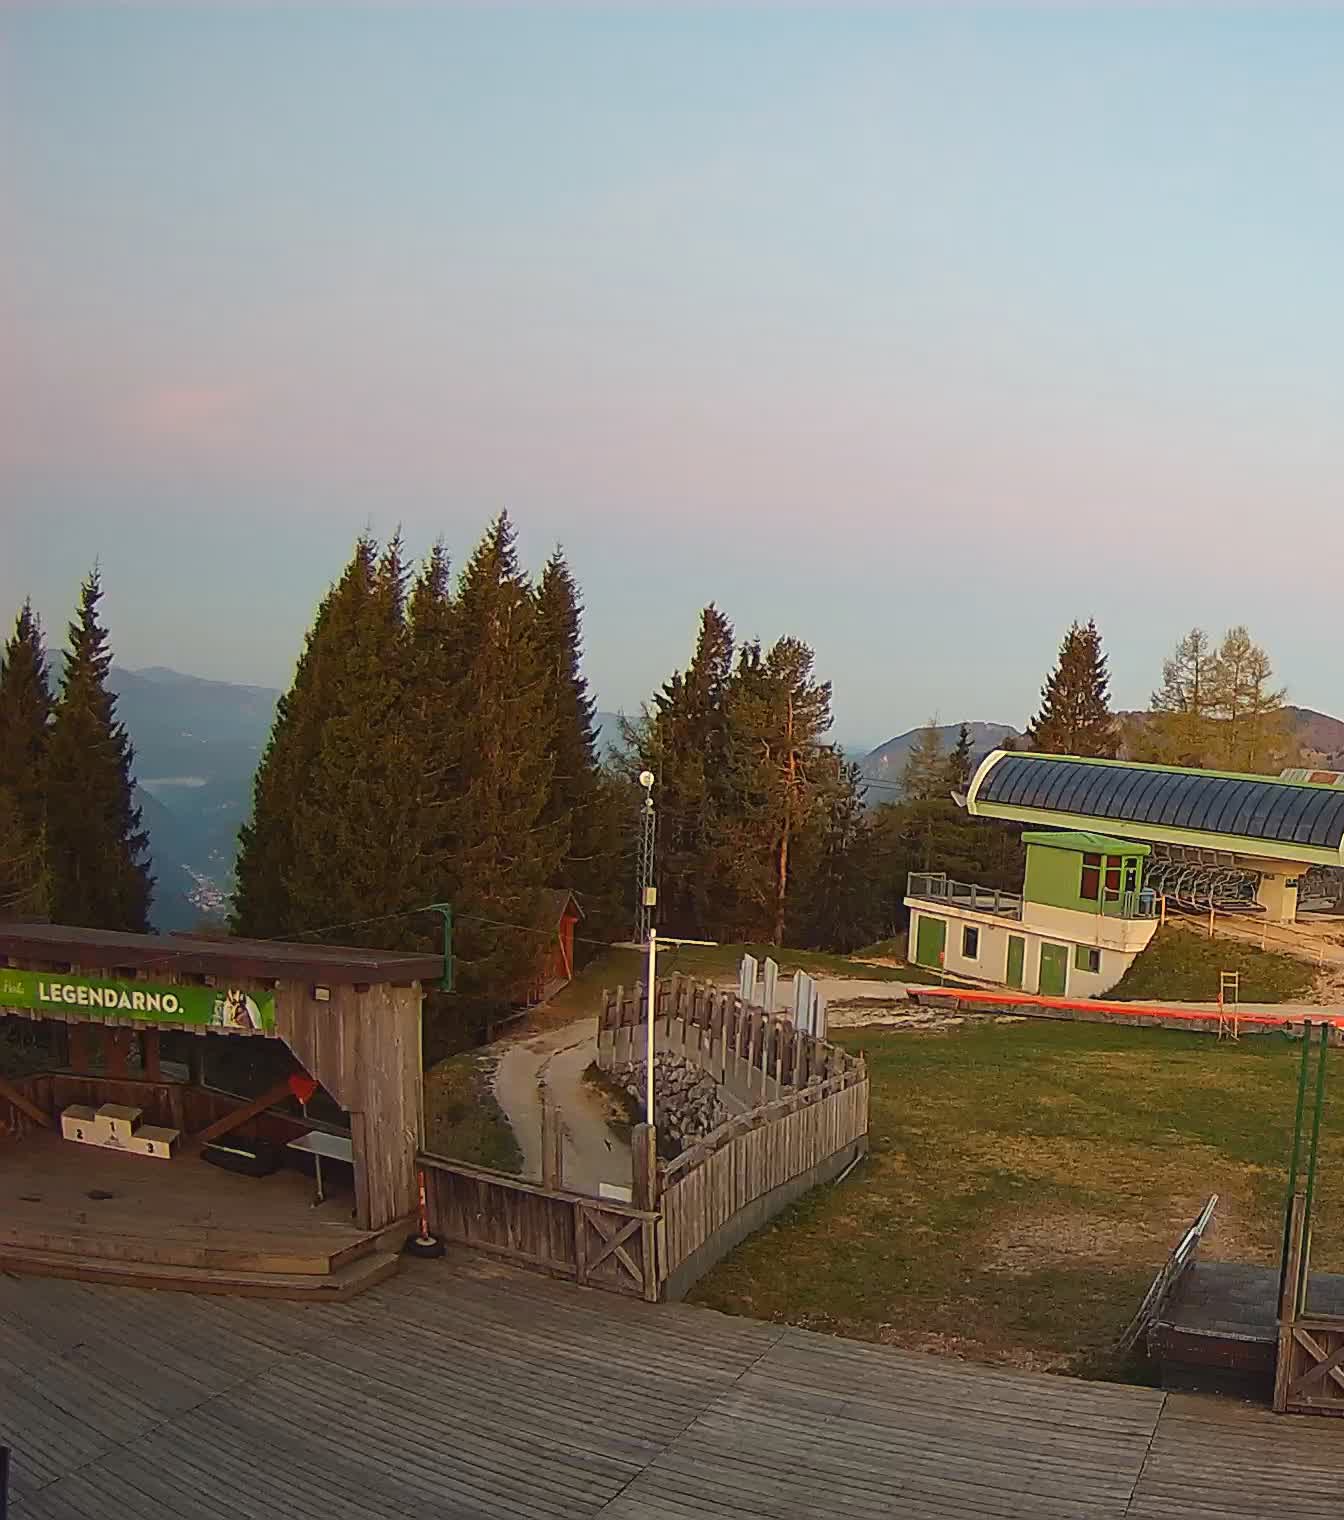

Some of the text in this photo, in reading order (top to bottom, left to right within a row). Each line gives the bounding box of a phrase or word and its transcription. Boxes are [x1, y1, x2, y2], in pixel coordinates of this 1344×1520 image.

[39, 982, 184, 1013] LEGENDARNO.
[76, 1128, 83, 1140] 2
[147, 1142, 154, 1153] 3
